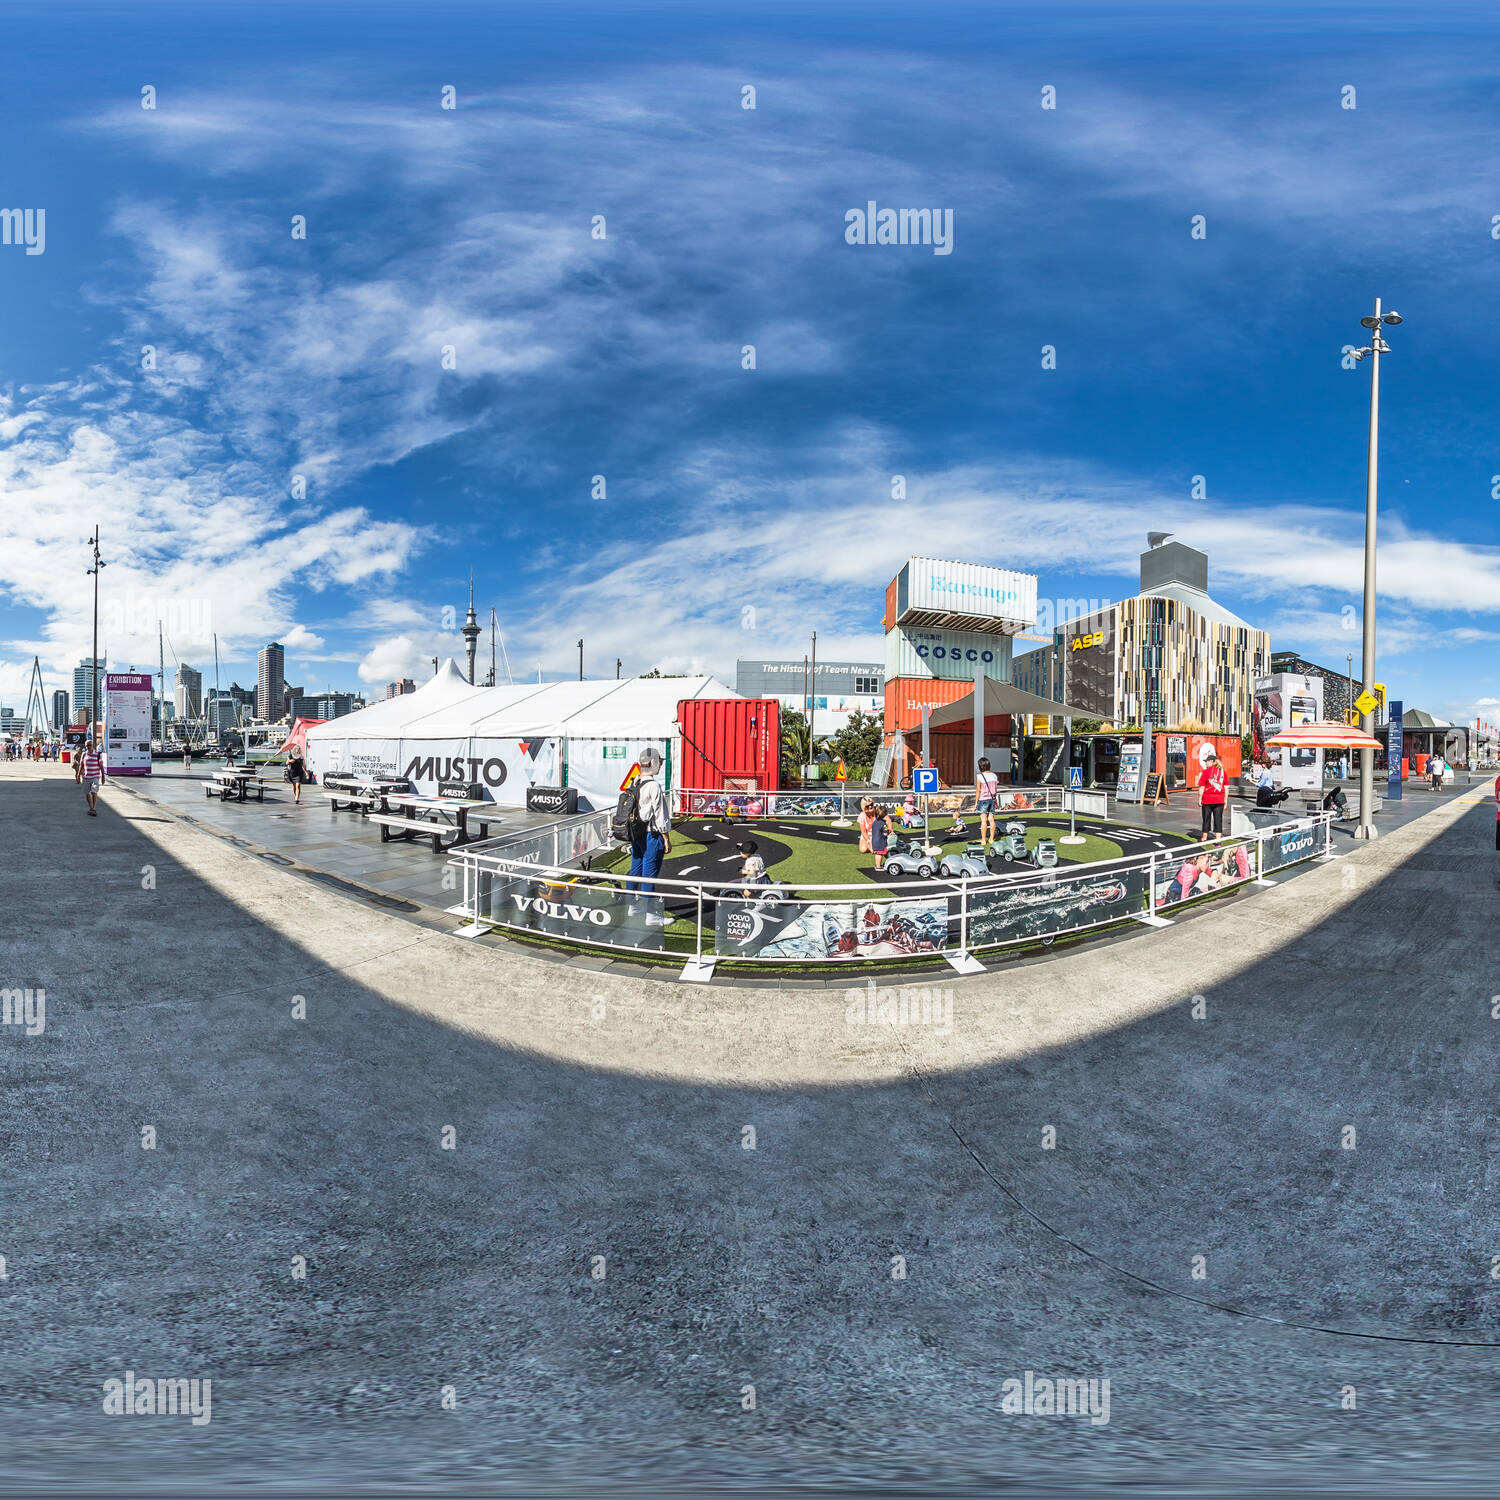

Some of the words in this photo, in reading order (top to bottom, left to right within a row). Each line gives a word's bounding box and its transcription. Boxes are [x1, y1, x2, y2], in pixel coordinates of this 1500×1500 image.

[1072, 631, 1104, 652] ASB
[916, 644, 994, 663] COSCO
[762, 664, 778, 673] The
[780, 664, 810, 675] History
[813, 665, 823, 675] of
[824, 666, 848, 674] Team
[850, 666, 870, 675] New
[109, 676, 142, 684] EXHIBITION
[907, 700, 950, 710] HAMBU
[404, 756, 508, 788] MUSTO
[920, 771, 934, 791] P
[441, 788, 468, 798] MUSTO
[530, 794, 562, 805] MUSTO
[1281, 837, 1314, 854] VOLVO
[510, 894, 612, 926] VOLVO
[728, 914, 750, 922] VOLVO
[728, 921, 751, 929] OCEAN
[728, 928, 745, 936] RACE
